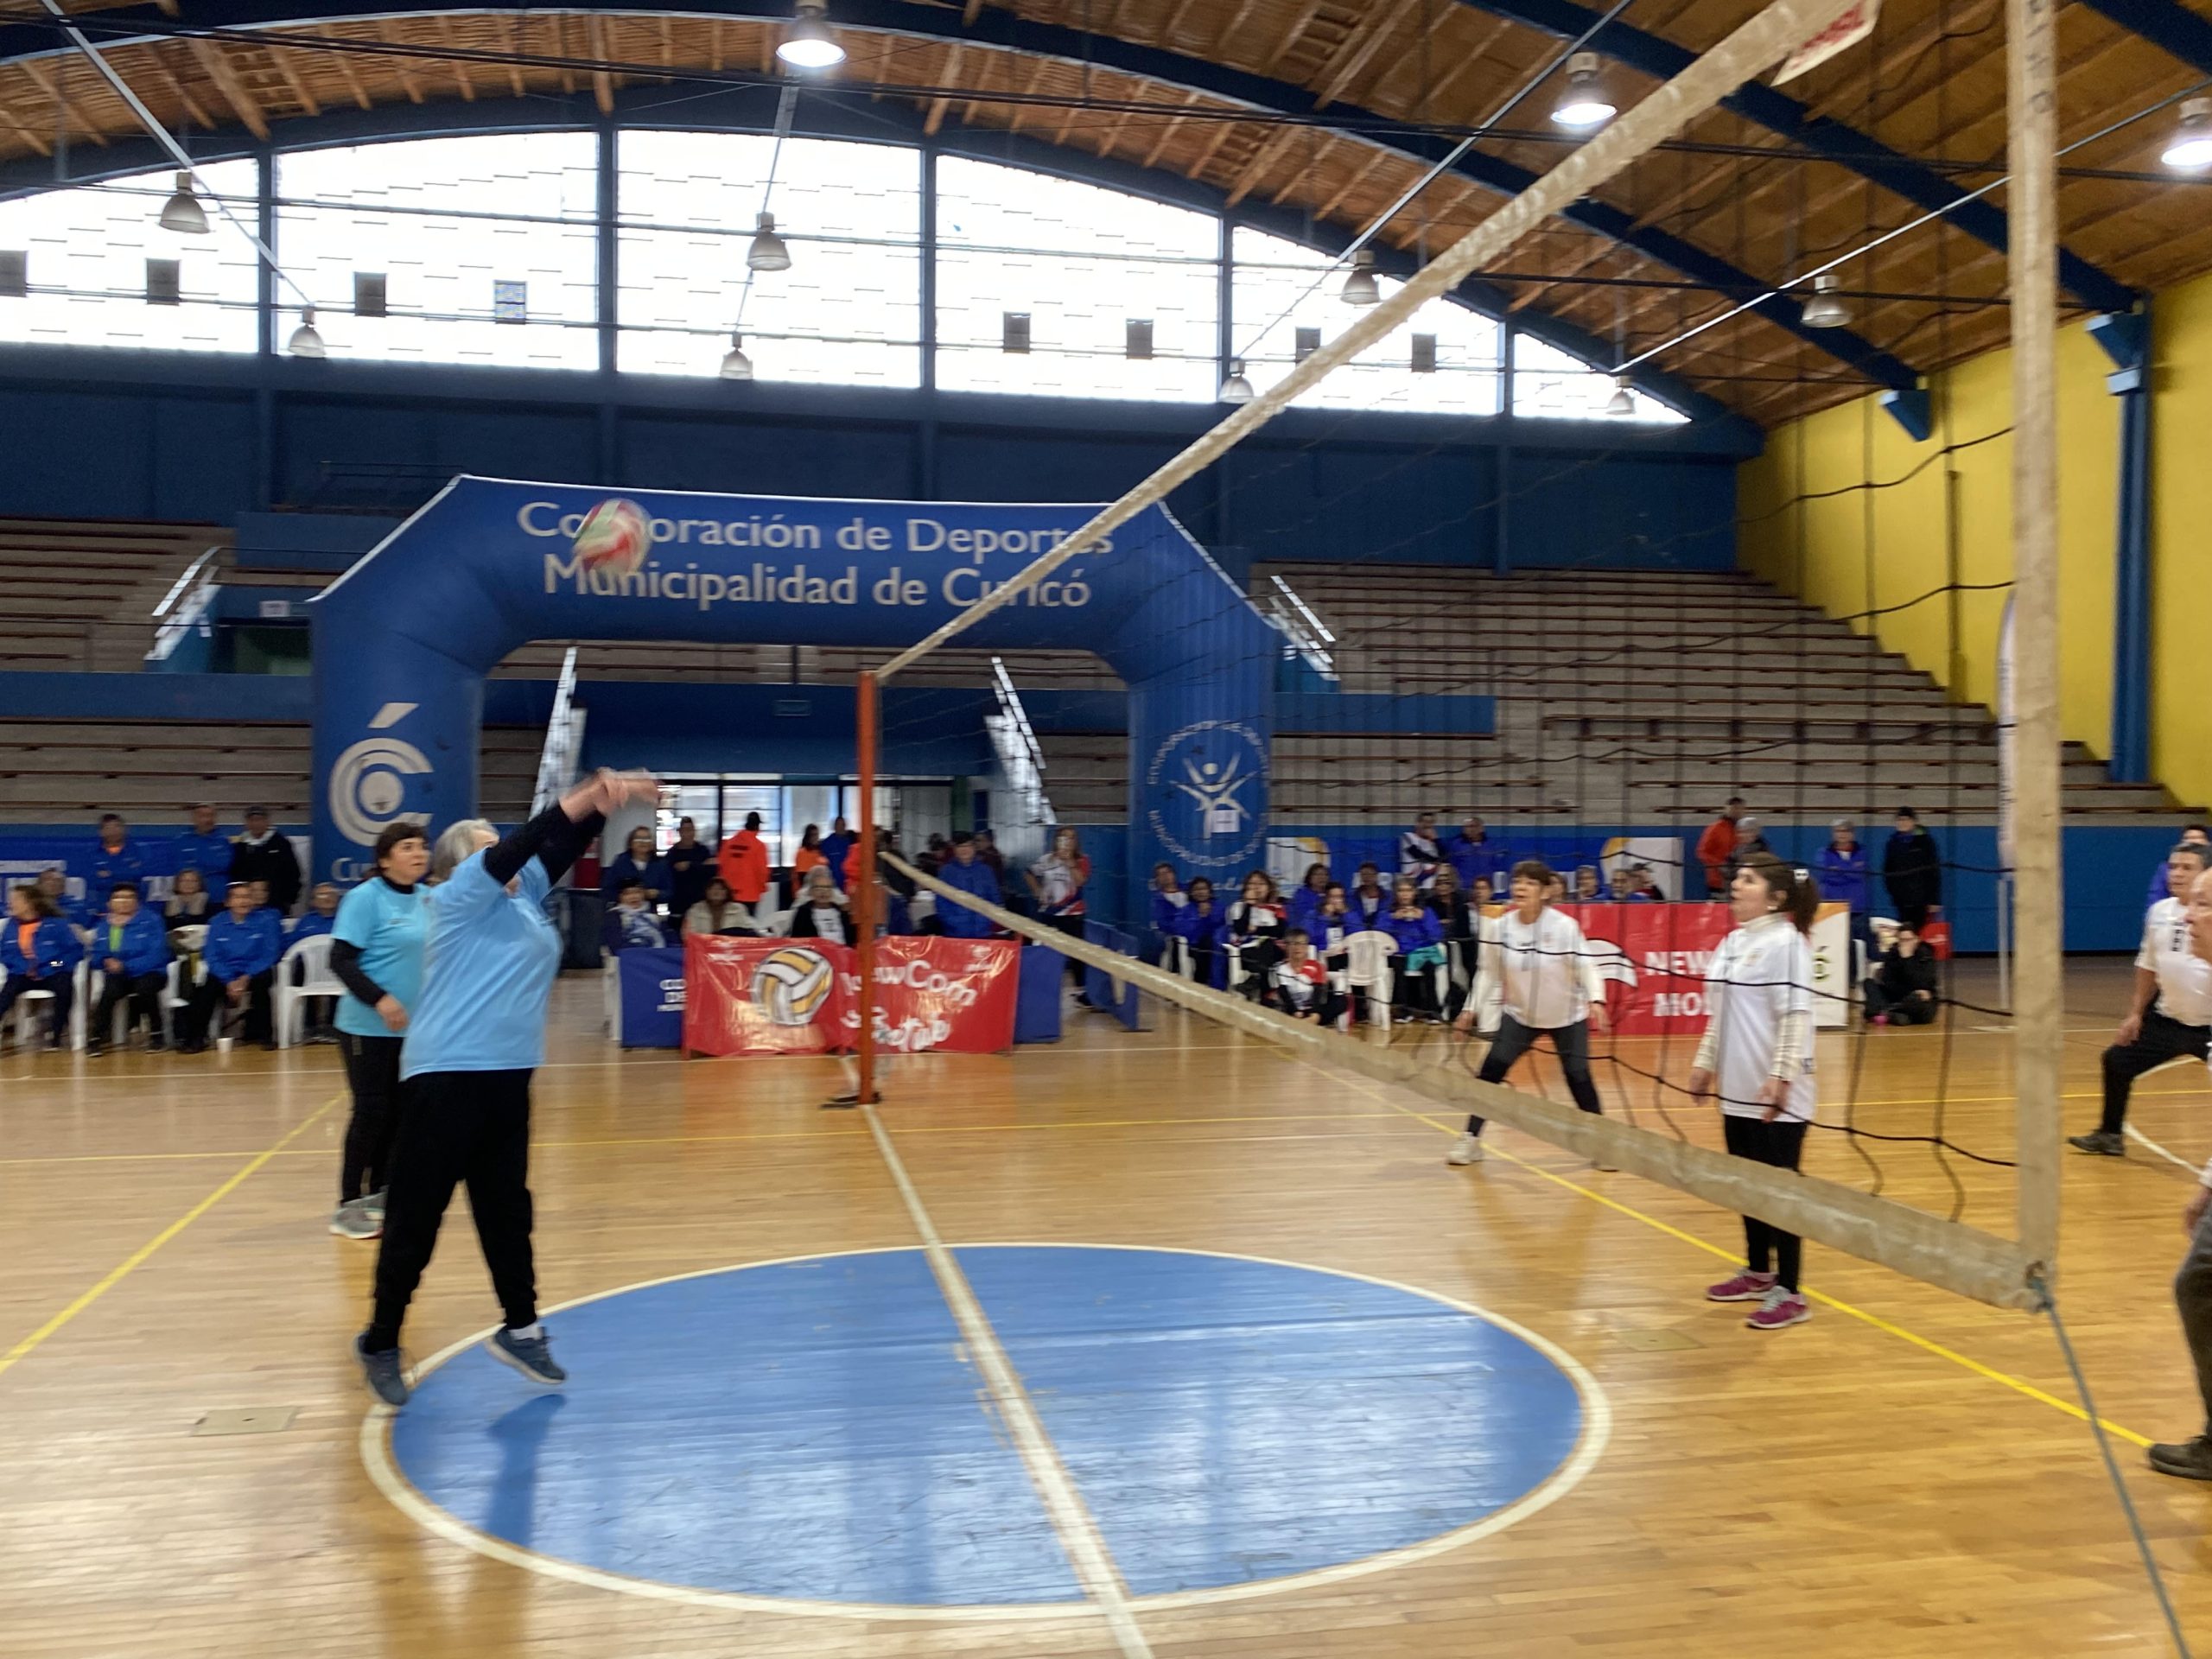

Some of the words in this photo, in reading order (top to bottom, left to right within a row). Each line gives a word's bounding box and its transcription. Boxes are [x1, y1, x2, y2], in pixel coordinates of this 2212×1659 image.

[517, 501, 821, 550] Cooración
[837, 518, 893, 552] de
[908, 518, 1115, 565] Deports
[543, 553, 857, 610] Municipalidad
[872, 568, 928, 606] de
[839, 959, 978, 1007] NwCom
